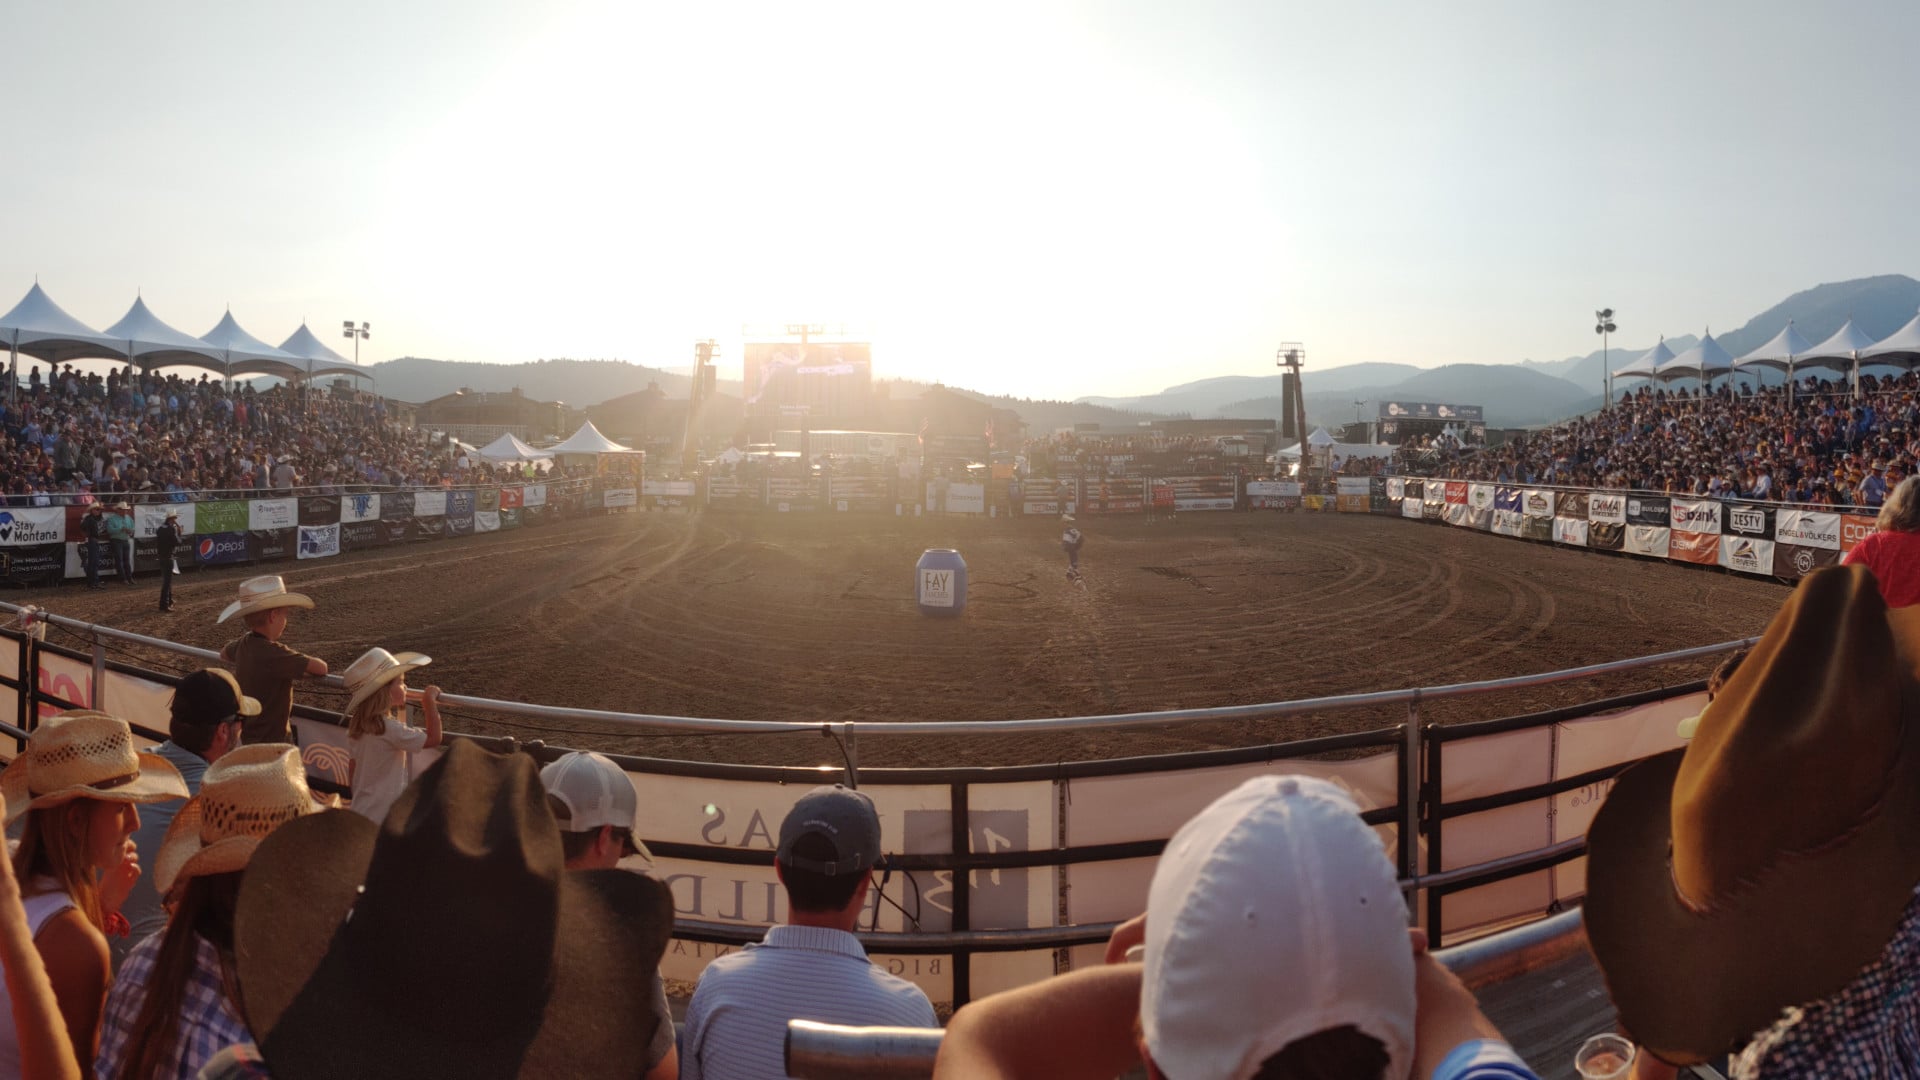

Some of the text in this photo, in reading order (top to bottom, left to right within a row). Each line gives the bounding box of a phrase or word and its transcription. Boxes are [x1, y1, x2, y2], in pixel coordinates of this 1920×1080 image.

[14, 520, 35, 532] Stay
[1733, 513, 1761, 527] ZESTY
[14, 530, 58, 542] Montana
[215, 539, 246, 554] pepsi
[11, 564, 61, 573] CONSTRUCTION
[925, 572, 949, 592] FAY
